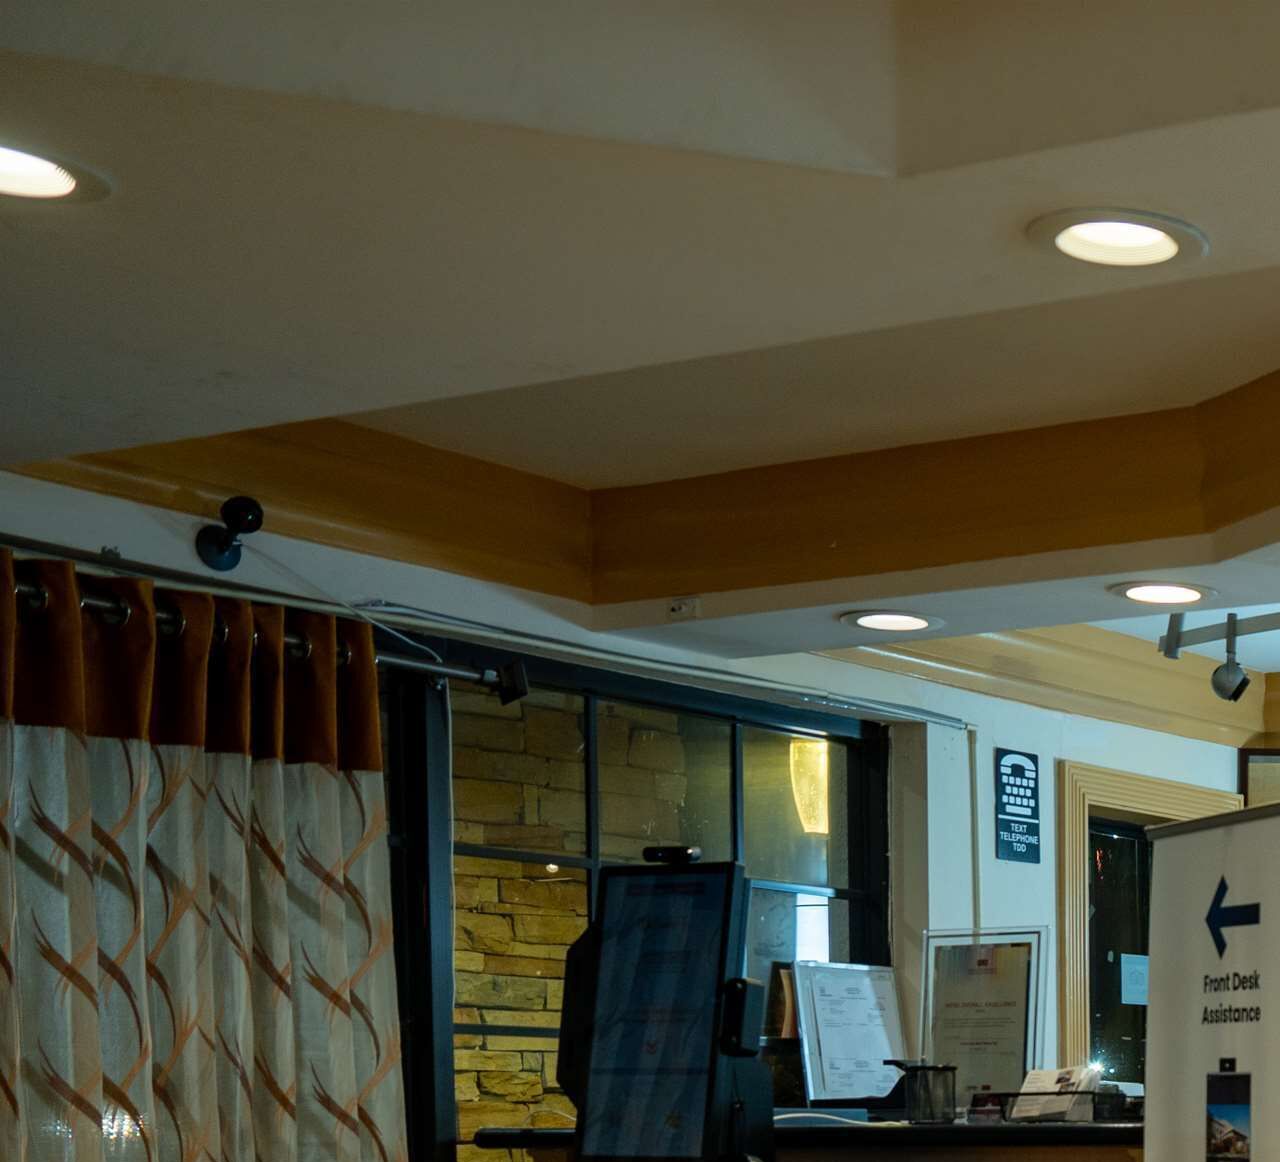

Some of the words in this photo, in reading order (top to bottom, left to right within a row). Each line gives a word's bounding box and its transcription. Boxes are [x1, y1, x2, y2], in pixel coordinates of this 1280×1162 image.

[1010, 823, 1027, 833] TEXT
[1000, 831, 1039, 845] TELEPHONE
[1013, 843, 1026, 852] TDD
[1203, 973, 1230, 993] Front
[1232, 969, 1261, 991] Desk
[1201, 1003, 1262, 1024] Assistance
